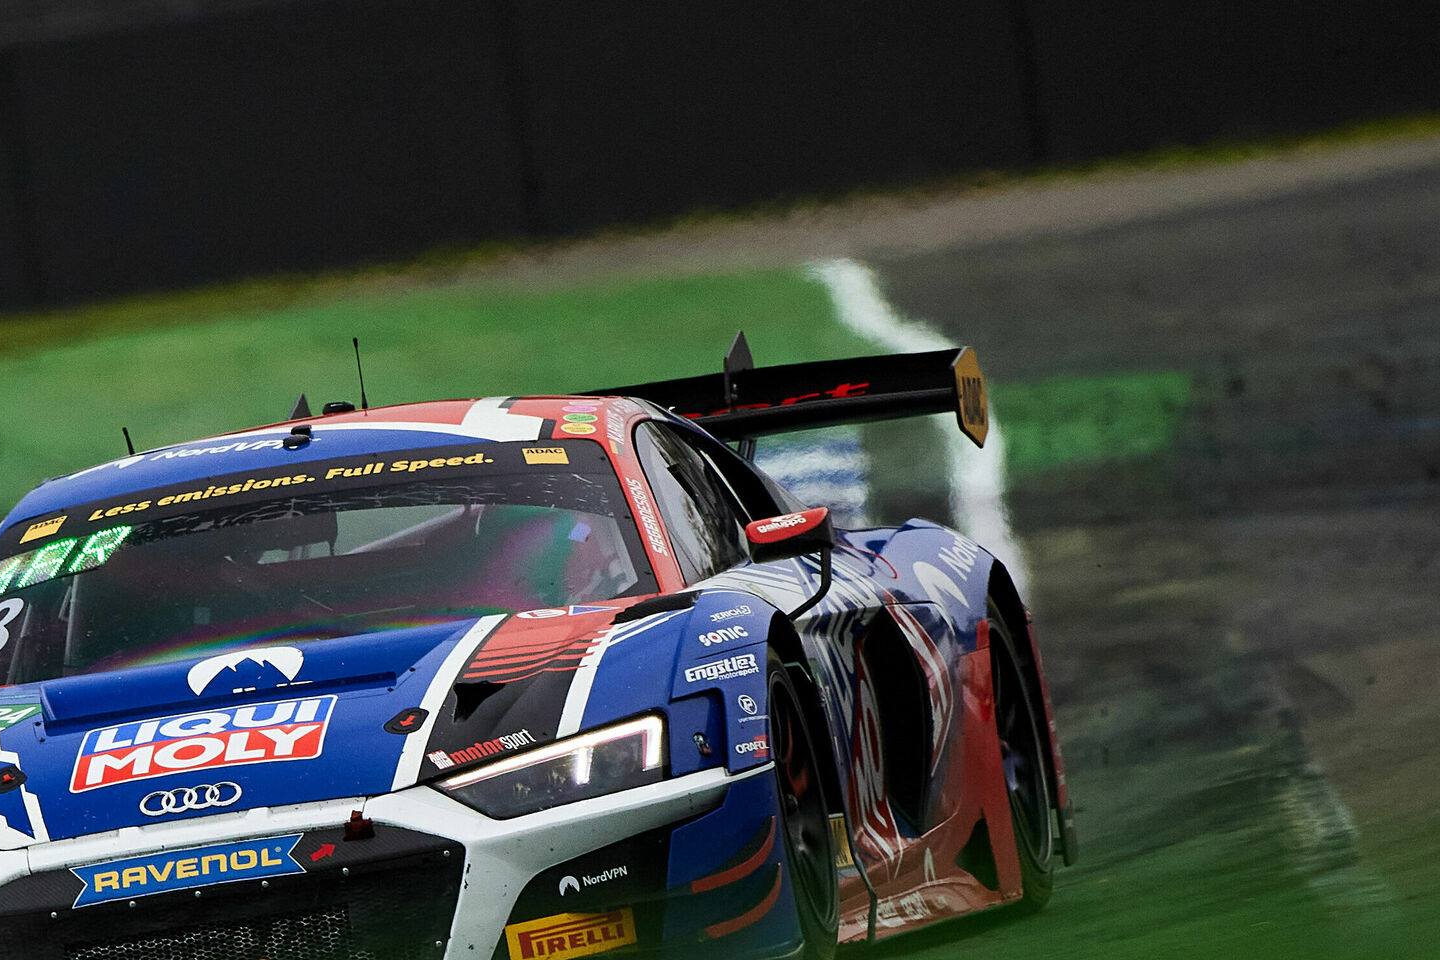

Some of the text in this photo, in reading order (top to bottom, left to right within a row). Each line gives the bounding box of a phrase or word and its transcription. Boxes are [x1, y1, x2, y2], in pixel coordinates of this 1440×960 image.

[152, 437, 322, 461] NordVP
[526, 447, 563, 455] ADAC
[88, 453, 495, 521] Less emissions. Full Speed.
[718, 667, 760, 681] motorsport
[94, 699, 322, 753] LIQUI
[85, 724, 322, 786] MOLY
[735, 740, 771, 754] ORAFOL
[93, 847, 283, 893] RAVENOL
[582, 865, 628, 887] NordVPN
[517, 910, 626, 960] PIRELLI
